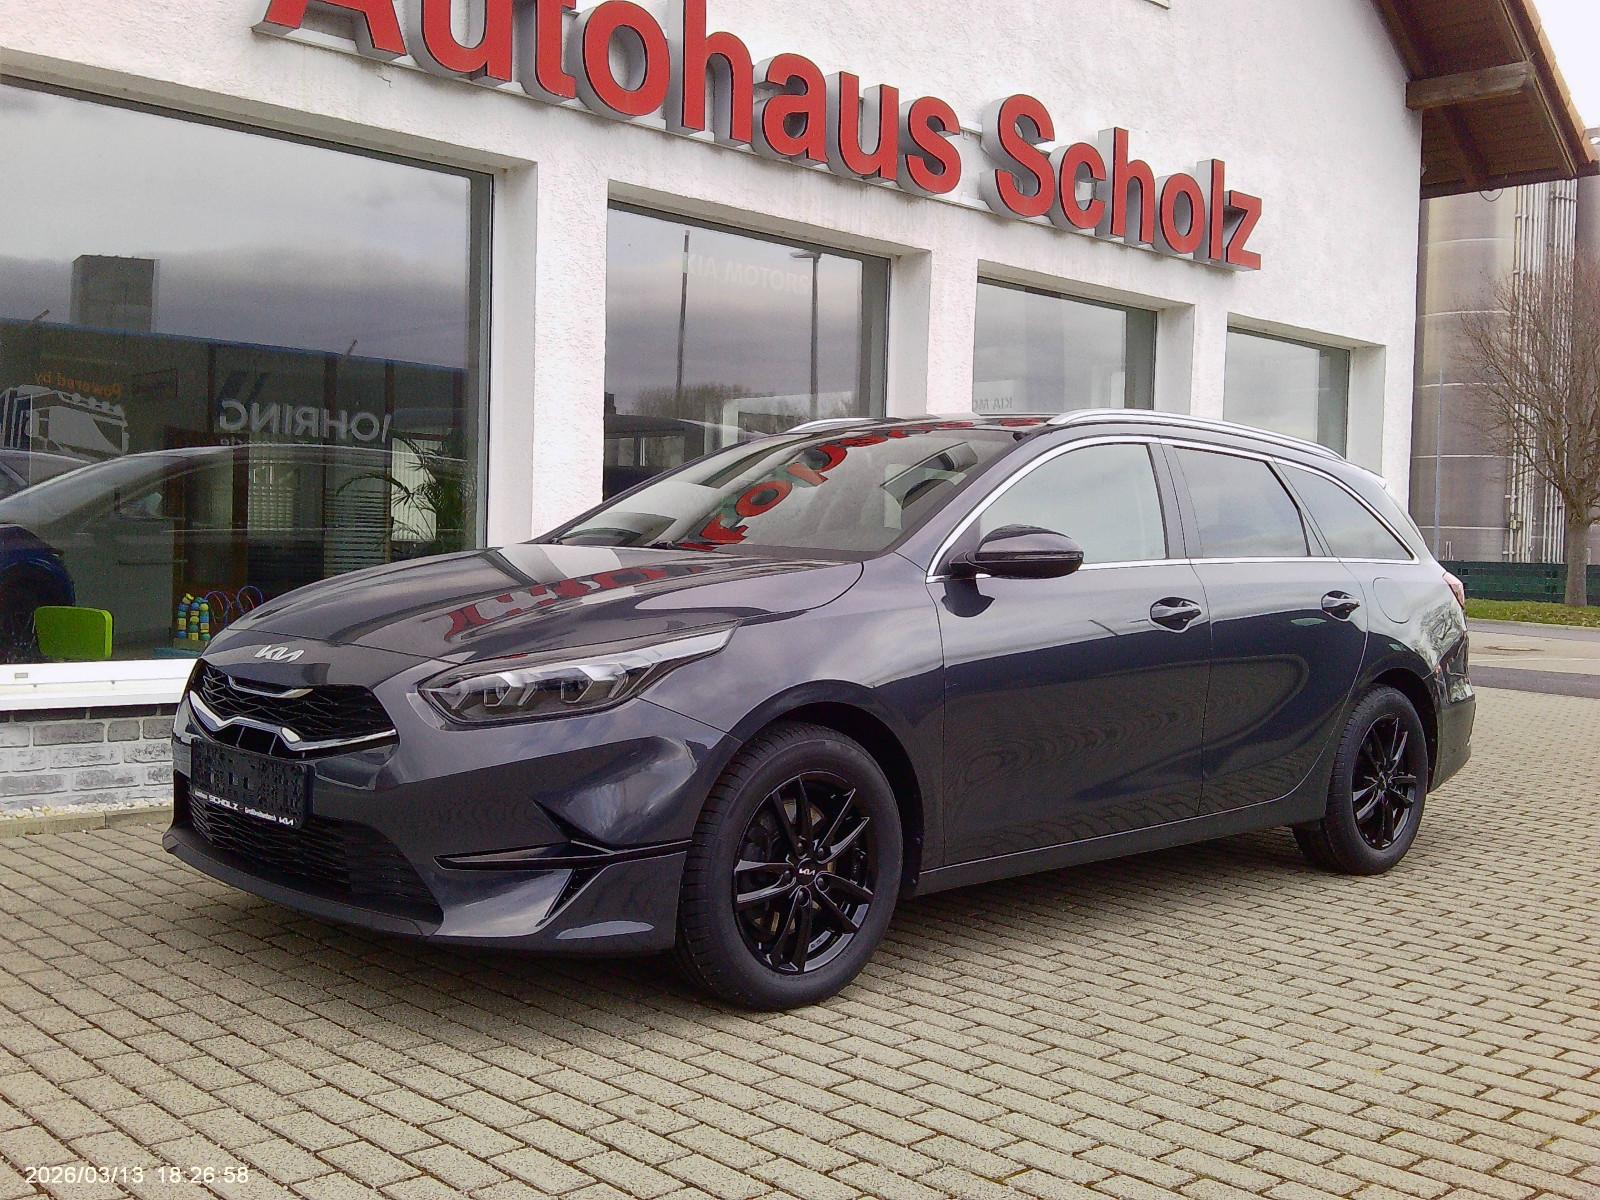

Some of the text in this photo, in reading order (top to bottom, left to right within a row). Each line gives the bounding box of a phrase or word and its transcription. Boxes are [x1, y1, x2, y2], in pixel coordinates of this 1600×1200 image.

[264, 0, 1263, 270] utohaus Scholz
[254, 645, 305, 663] KIA
